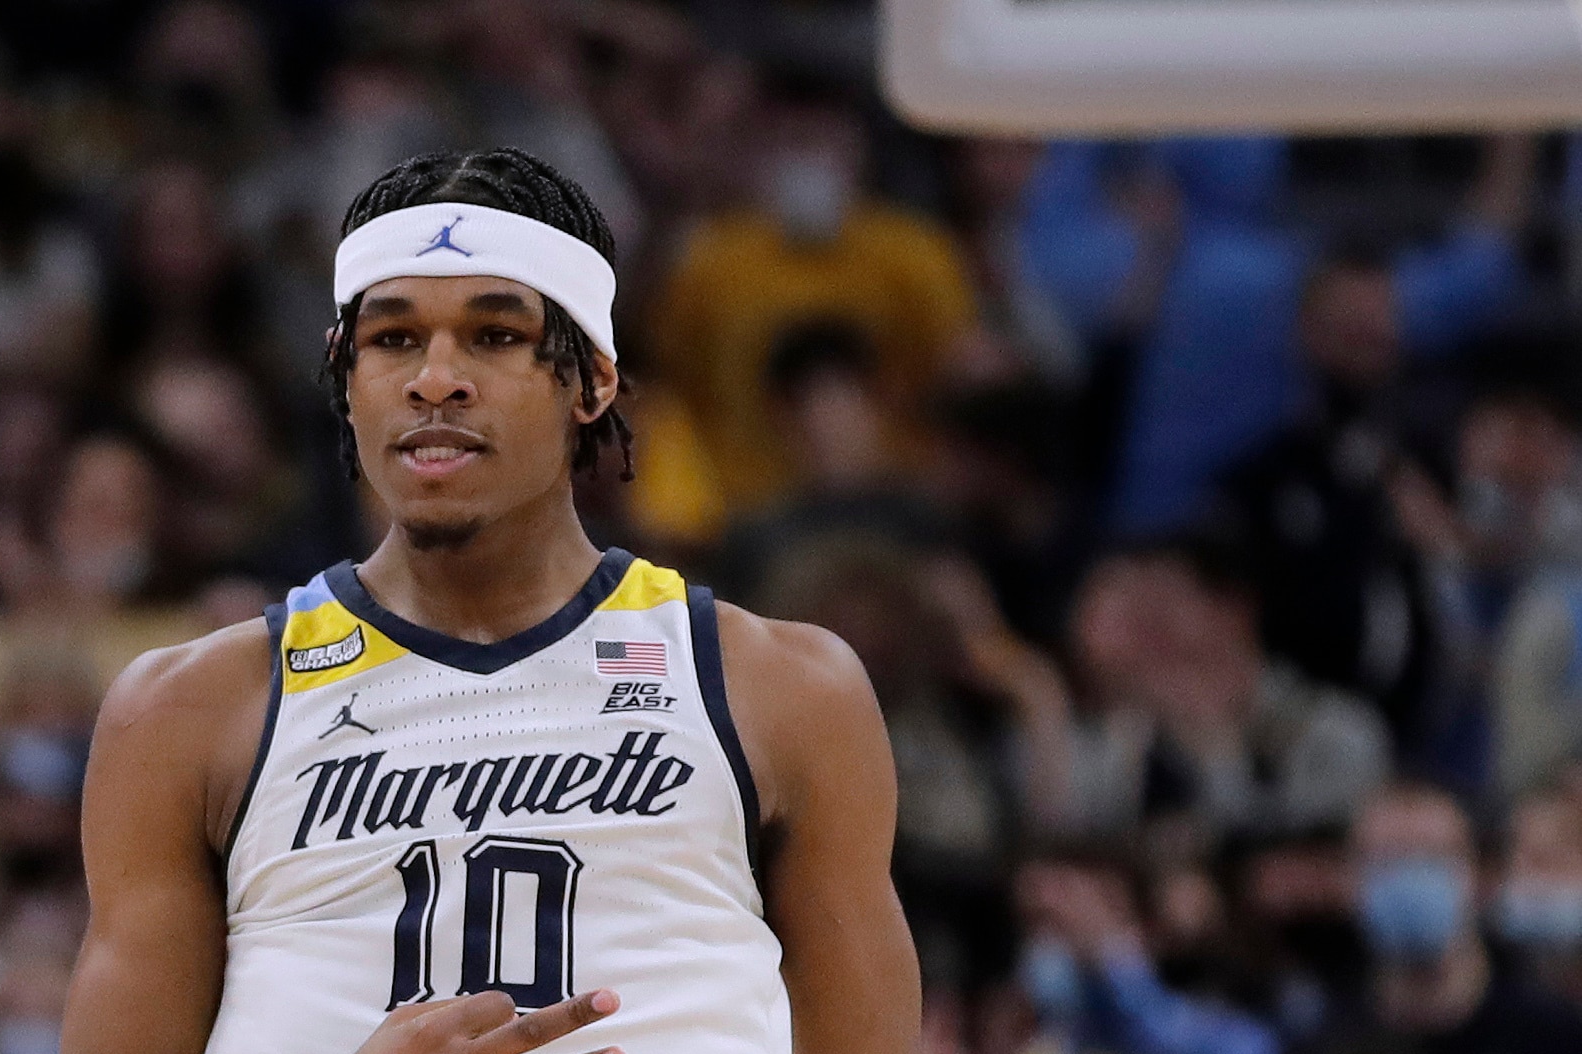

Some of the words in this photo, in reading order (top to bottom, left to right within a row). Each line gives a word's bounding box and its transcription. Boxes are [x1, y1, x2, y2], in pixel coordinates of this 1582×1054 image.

[604, 695, 678, 708] EAST
[611, 682, 663, 695] BIG
[291, 731, 695, 851] Marquette
[385, 834, 585, 1015] 10
